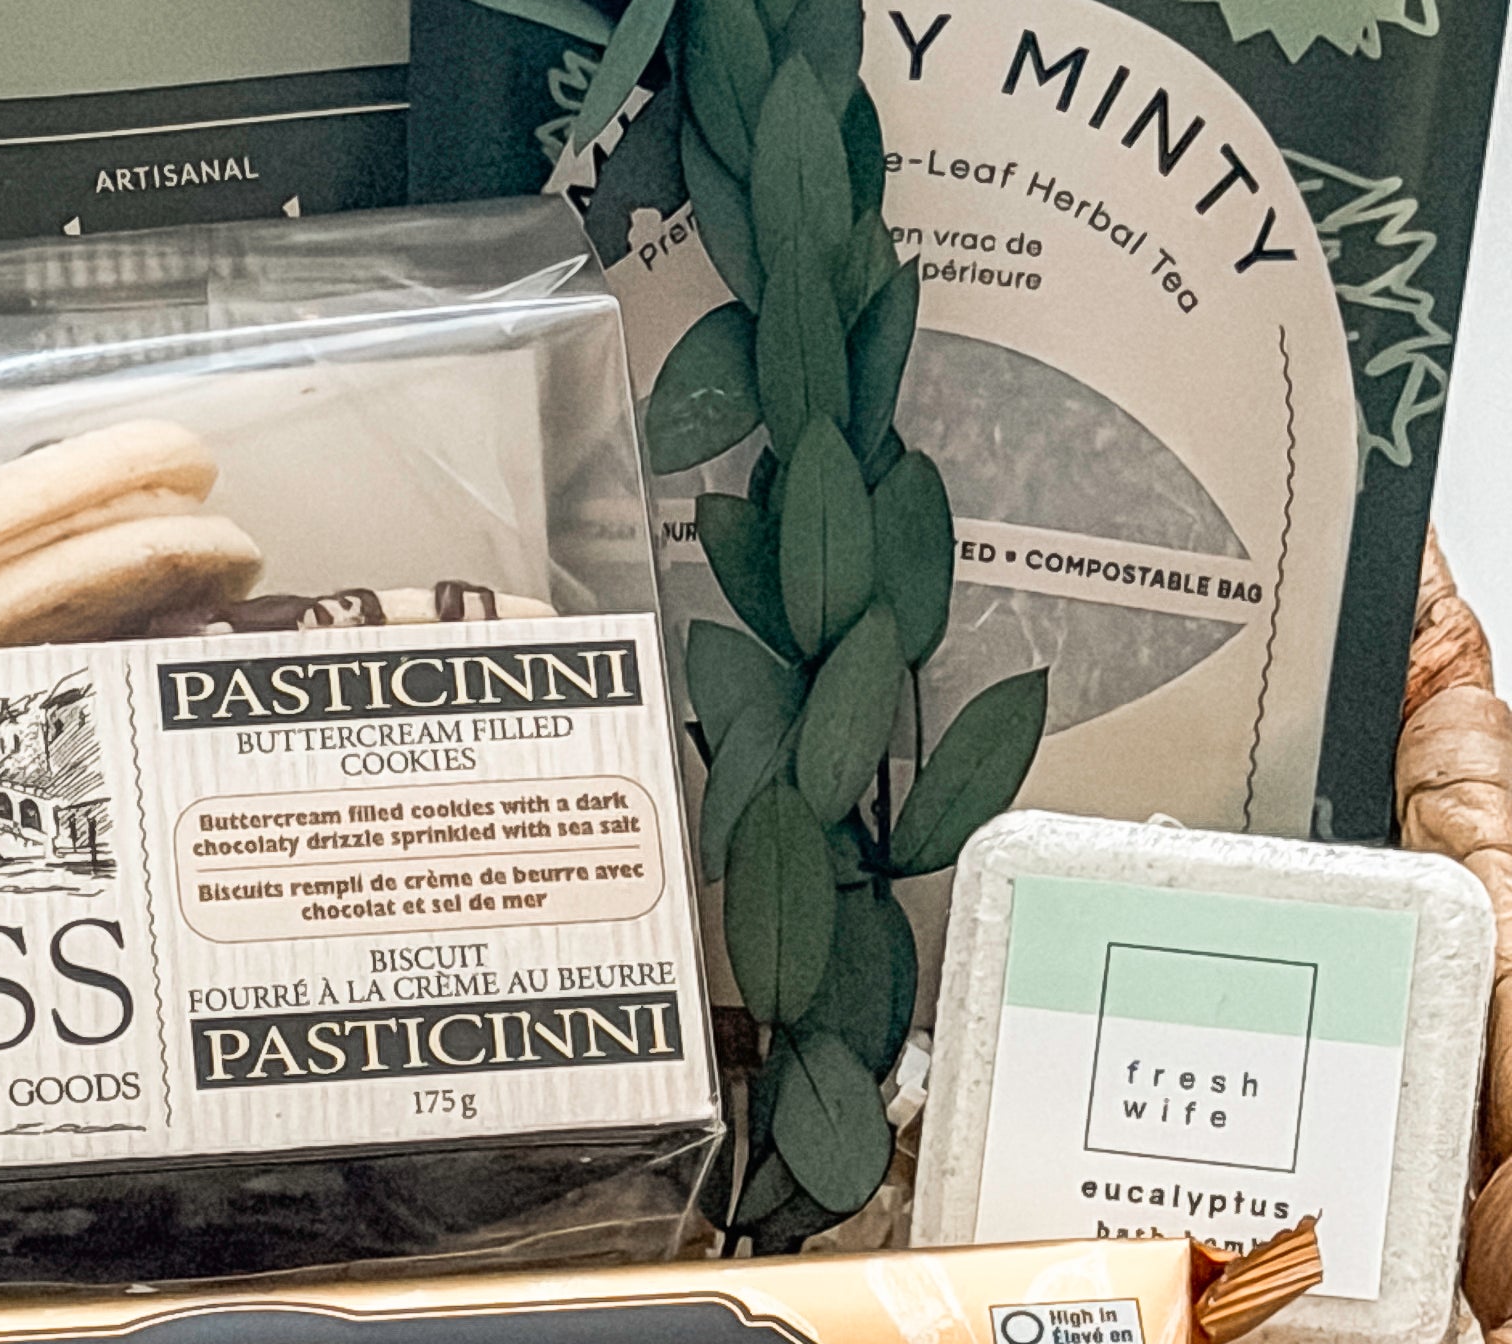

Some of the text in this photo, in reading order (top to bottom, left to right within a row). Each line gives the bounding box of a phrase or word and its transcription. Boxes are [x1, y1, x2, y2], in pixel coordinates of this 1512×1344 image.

[1002, 30, 1297, 275] MINTY
[96, 156, 258, 194] ARTISANAL
[884, 149, 1018, 189] e-Leaf
[1026, 171, 1146, 257] Herbal
[1148, 248, 1199, 314] Tea
[1006, 232, 1043, 257] de
[922, 259, 1043, 291] périeure
[1025, 549, 1209, 597] COMPOSTABLE
[1217, 579, 1262, 604] BAG
[169, 649, 634, 722] PASTICINNI
[237, 714, 574, 754] BUTTERCREAM FILLED
[341, 748, 477, 777] COOKIES
[199, 791, 628, 832] Buttercream filled cookies with a dark
[192, 815, 641, 858] chocolaty drizzle sprinkled with sea salt
[198, 862, 645, 902] Biscuits rempli de crème de beurre avec
[301, 892, 548, 922] chocolat et sel de mer
[370, 944, 489, 974] BISCUIT
[188, 963, 676, 1014] FOURRÉ À LA CRÈME AU BEURRE
[203, 1002, 676, 1083] PASTICINNI
[9, 1072, 141, 1106] GOODS
[1127, 1060, 1258, 1098] fresh
[1123, 1098, 1227, 1128] wife
[1081, 1181, 1289, 1219] eucalyptus
[1049, 1307, 1118, 1326] High in
